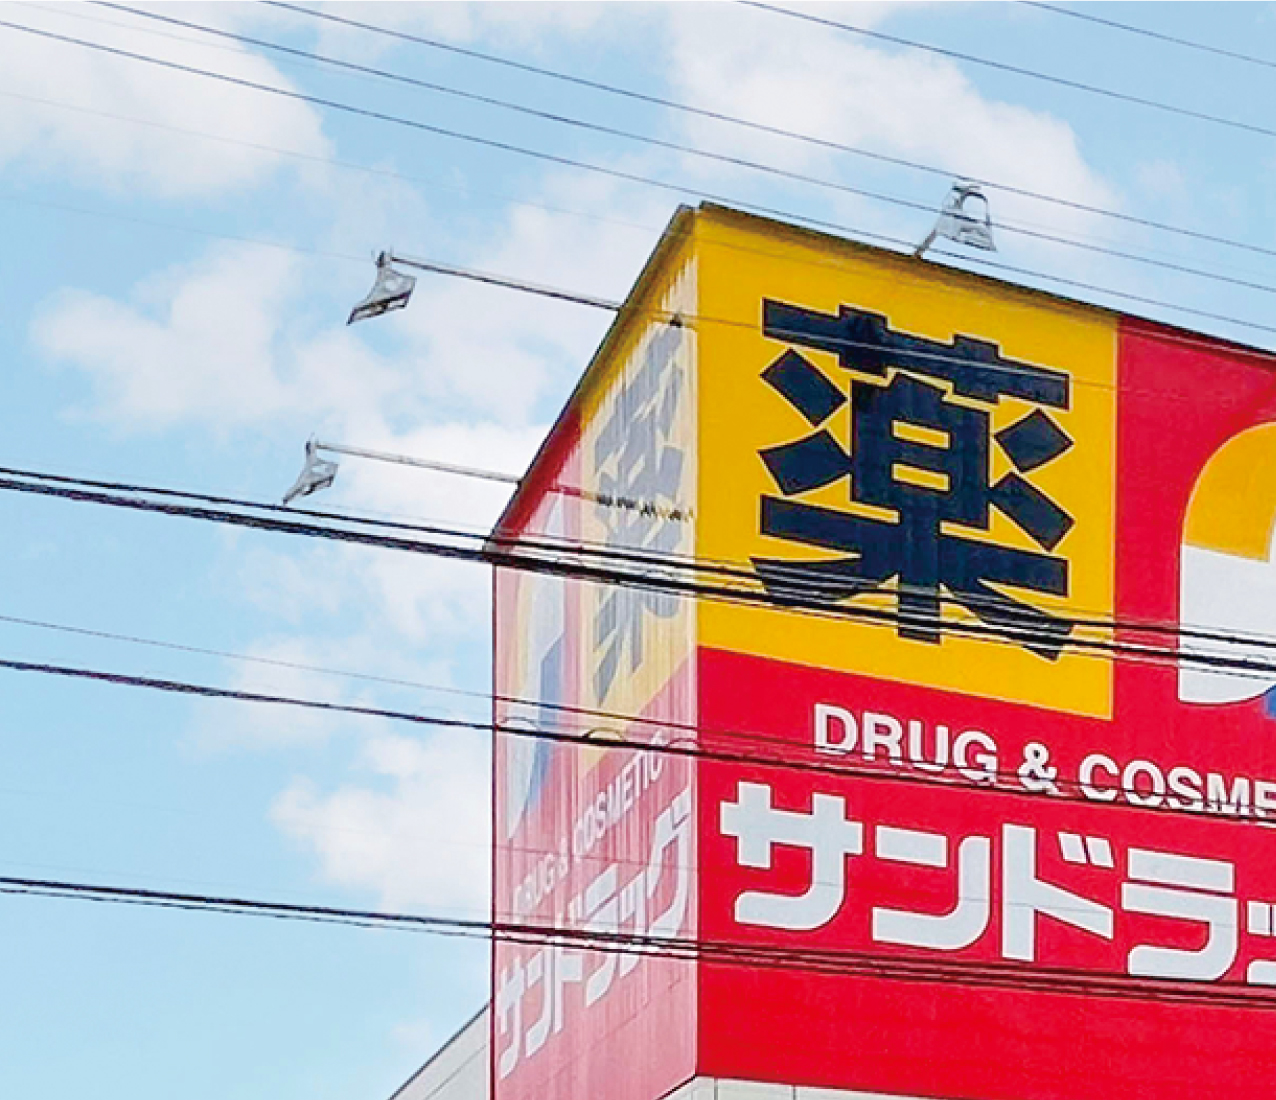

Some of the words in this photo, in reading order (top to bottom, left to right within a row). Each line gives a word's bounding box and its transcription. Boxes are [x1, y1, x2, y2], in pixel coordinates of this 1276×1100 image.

[750, 298, 1075, 660] 薬
[813, 703, 998, 782] DRUG
[1017, 741, 1059, 795] &
[496, 786, 692, 1080] サンドラッグ
